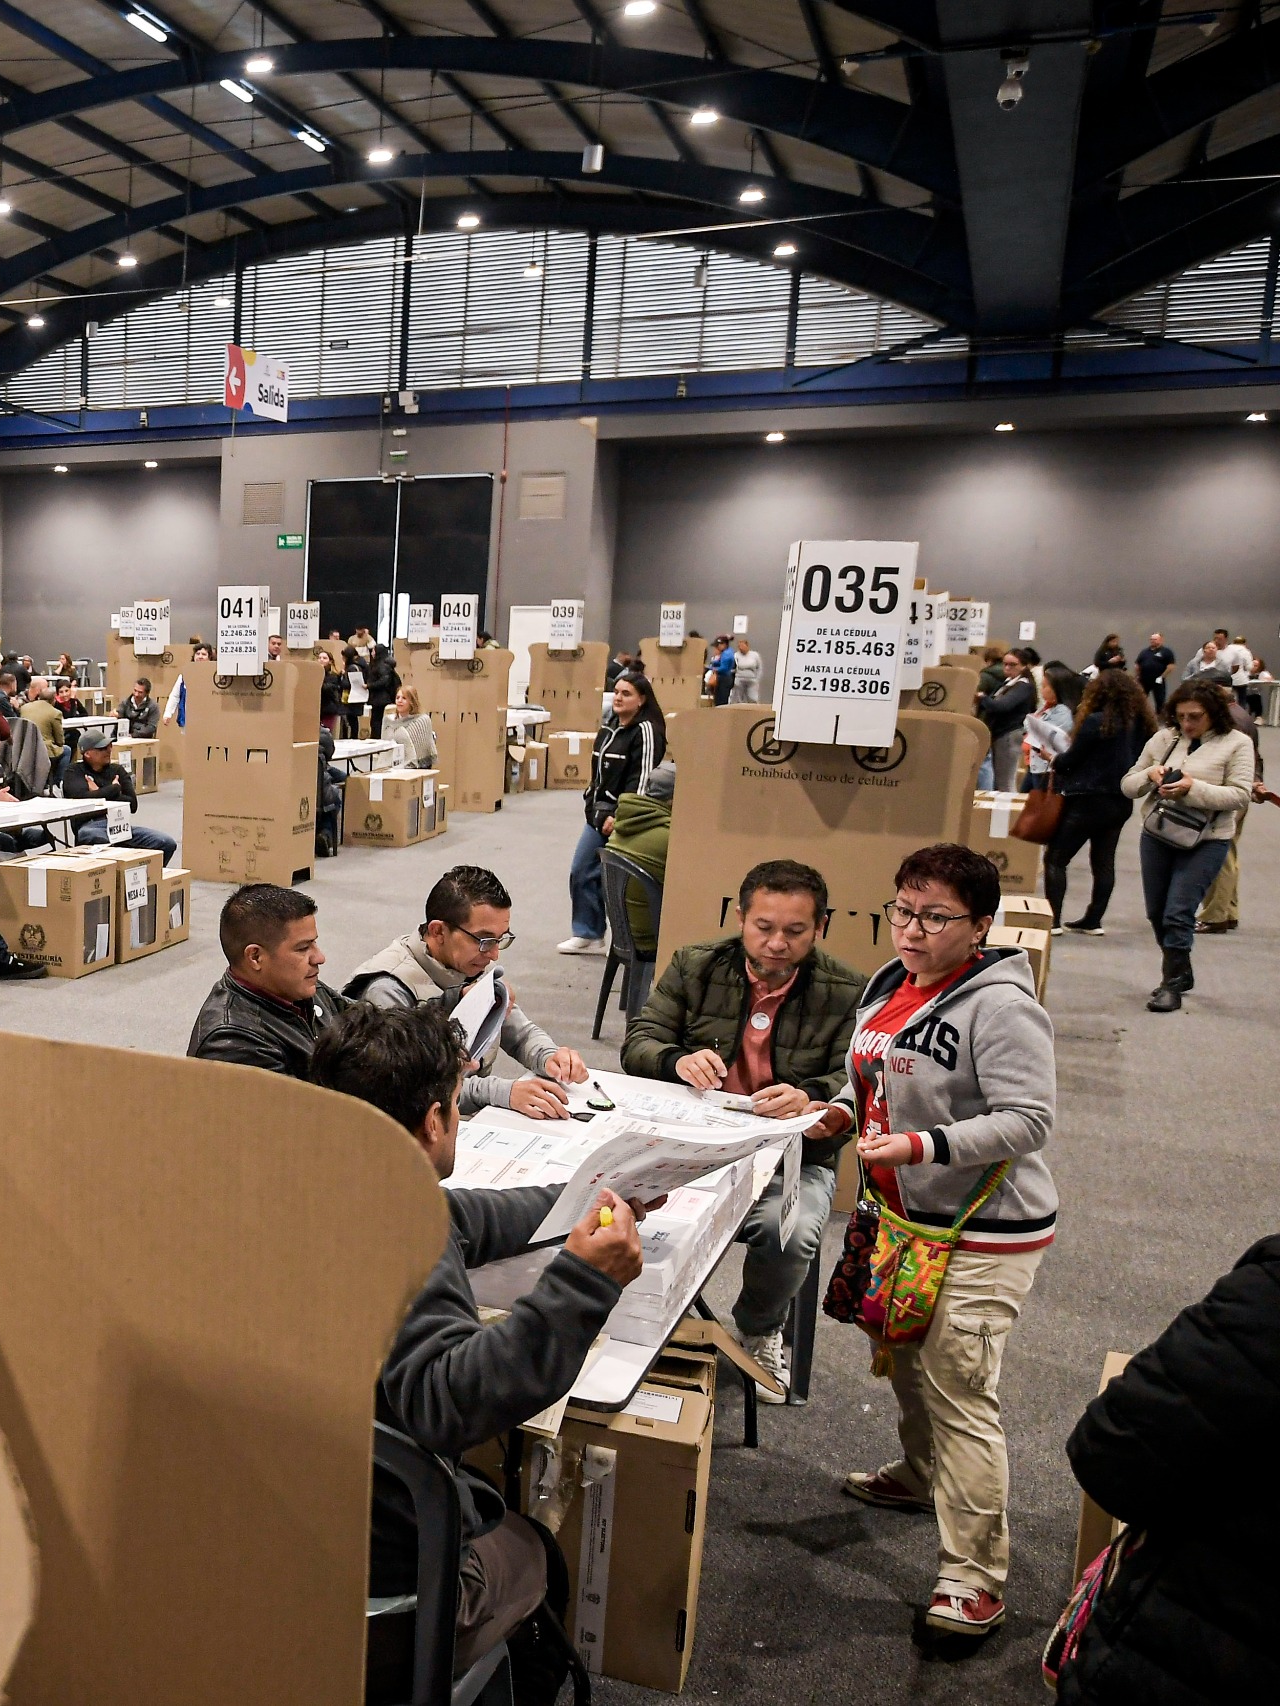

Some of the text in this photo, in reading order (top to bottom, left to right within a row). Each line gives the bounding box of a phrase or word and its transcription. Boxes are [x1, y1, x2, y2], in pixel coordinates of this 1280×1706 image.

[258, 383, 284, 408] Salida
[801, 564, 900, 614] 035
[121, 610, 134, 618] 057
[136, 607, 157, 620] 049
[221, 597, 253, 618] 041
[289, 609, 309, 620] 048
[411, 609, 428, 618] 047
[443, 602, 471, 617] 040
[552, 606, 575, 618] 039
[662, 610, 682, 620] 038
[970, 608, 983, 619] 31
[796, 639, 895, 657] 52.185.463
[804, 665, 831, 673] HASTA
[833, 666, 844, 674] LA
[791, 676, 890, 695] 52.198.306
[741, 766, 900, 787] Prohibido el uso de celular
[894, 1015, 960, 1071] RIS
[890, 1056, 916, 1075] NCE
